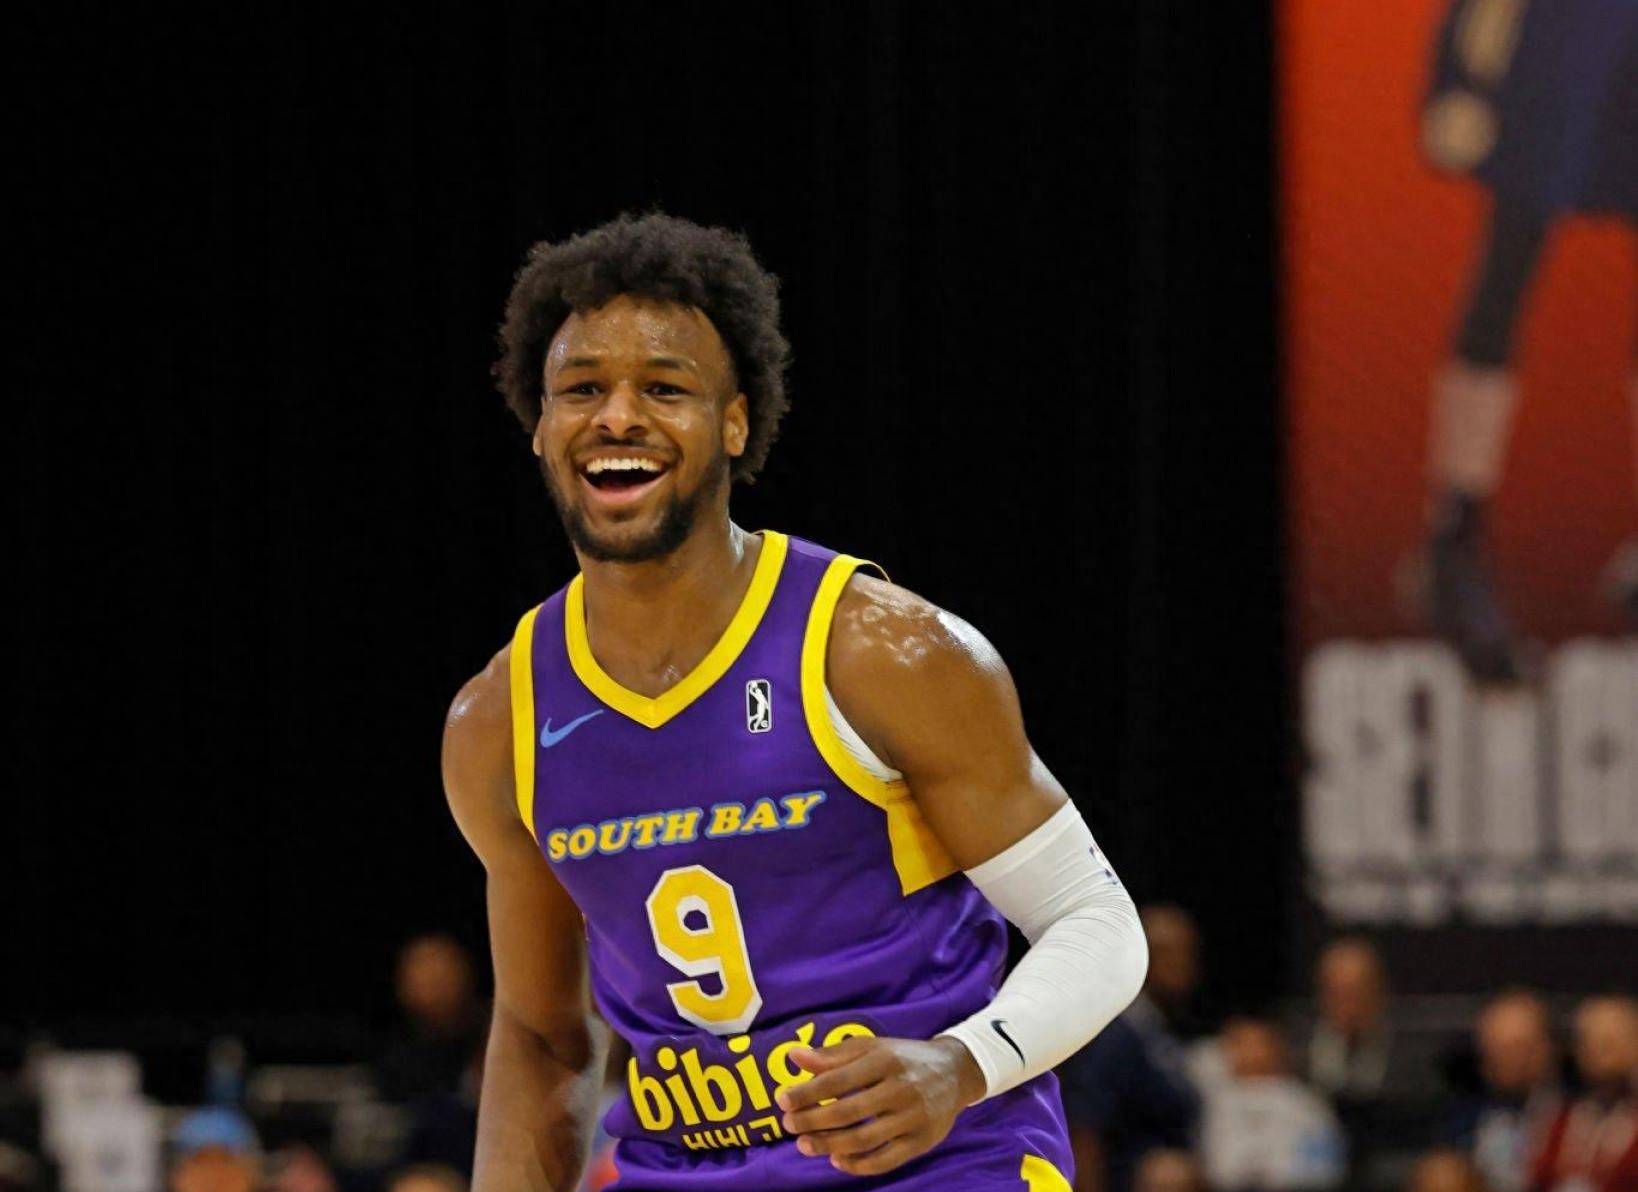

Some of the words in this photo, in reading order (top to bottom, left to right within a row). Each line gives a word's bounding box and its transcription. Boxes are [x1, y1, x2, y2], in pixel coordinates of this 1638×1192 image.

[547, 807, 704, 862] SOUTH
[705, 791, 827, 839] BAY
[645, 864, 763, 1036] 9
